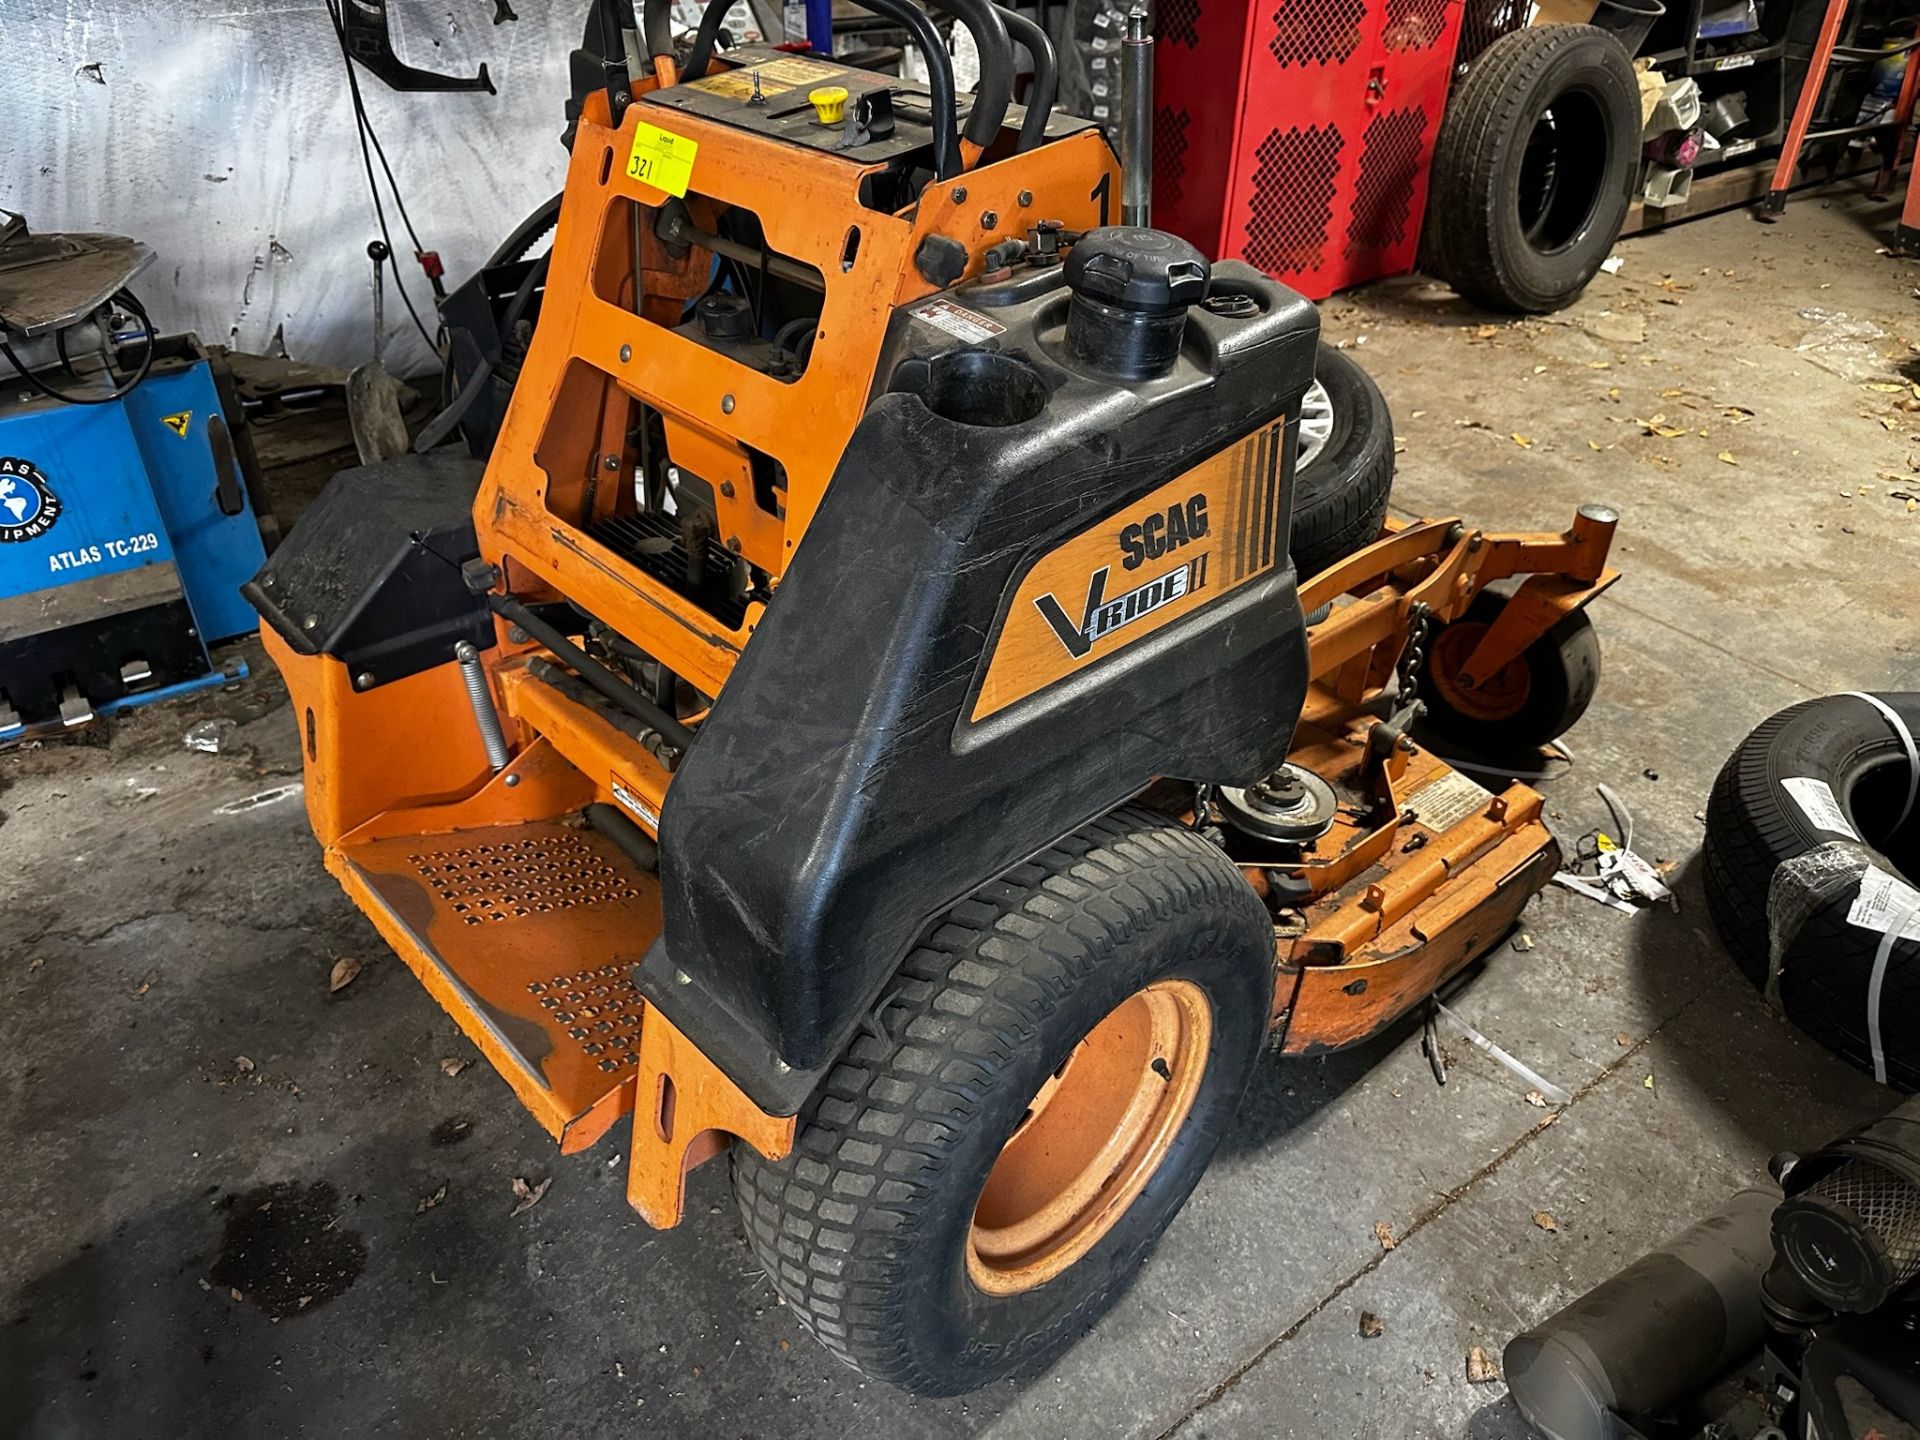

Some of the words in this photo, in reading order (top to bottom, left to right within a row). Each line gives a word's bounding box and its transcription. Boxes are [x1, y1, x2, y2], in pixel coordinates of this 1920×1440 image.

[630, 155, 653, 180] 321
[1090, 172, 1111, 227] 1
[954, 309, 993, 329] DANGER
[49, 545, 102, 572] ATLAS
[104, 532, 159, 558] TC-229
[1119, 493, 1209, 571] SCAG
